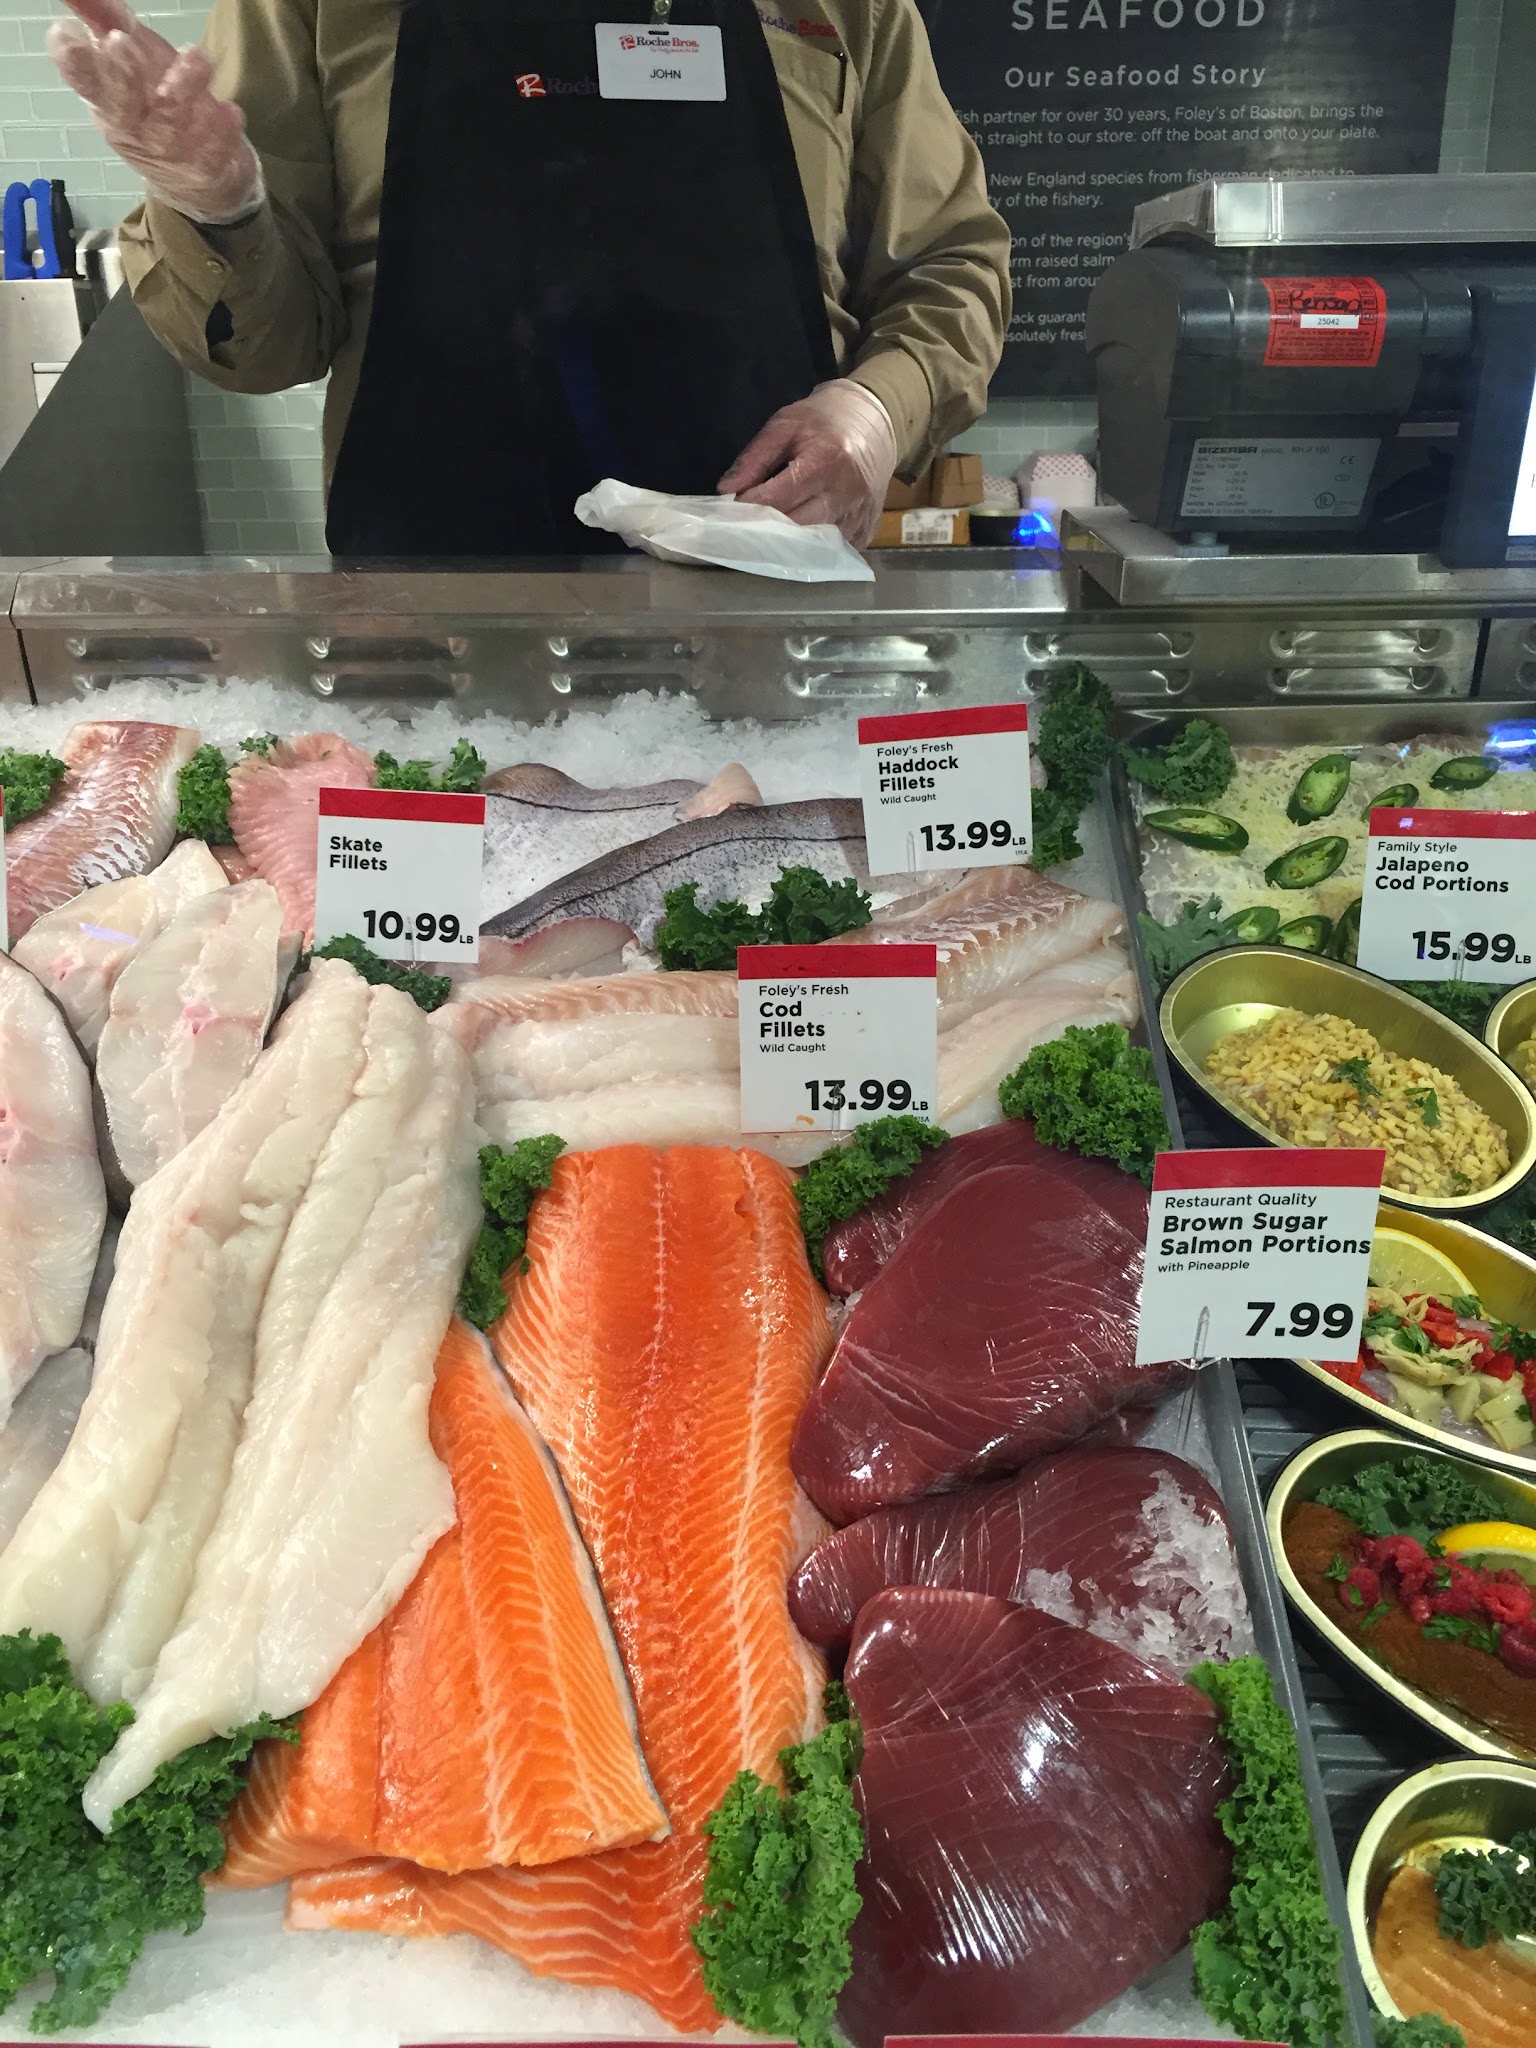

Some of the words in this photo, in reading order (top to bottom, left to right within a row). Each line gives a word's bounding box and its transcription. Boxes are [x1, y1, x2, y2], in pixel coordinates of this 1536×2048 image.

[1011, 0, 1265, 31] SEAFOOD
[636, 36, 671, 47] Roche
[672, 37, 699, 47] Bros.
[650, 69, 682, 80] JOHN
[1005, 67, 1054, 88] Our
[1066, 64, 1179, 87] Seafood
[1192, 64, 1265, 88] Story
[984, 110, 1037, 126] partner
[1041, 109, 1063, 122] for
[1067, 111, 1099, 122] over
[1105, 107, 1123, 121] 30
[1128, 109, 1170, 124] years,
[1175, 105, 1226, 122] Foley's
[1230, 104, 1246, 119] of
[1250, 105, 1305, 120] Boston,
[1310, 105, 1355, 121] brings
[1360, 104, 1384, 118] the
[988, 130, 1042, 146] straight
[1048, 132, 1063, 143] to
[1067, 133, 1090, 143] our
[1096, 130, 1137, 143] store:
[1141, 128, 1162, 142] off
[1166, 128, 1190, 141] the
[1194, 127, 1227, 141] boat
[1232, 126, 1259, 140] and
[1264, 128, 1297, 140] onto
[1301, 128, 1335, 142] your
[1340, 125, 1380, 141] plate.
[991, 173, 1022, 185] New
[1028, 171, 1085, 188] England
[1090, 170, 1143, 187] species
[1148, 169, 1182, 184] from
[1005, 192, 1021, 207] of
[1025, 193, 1047, 206] the
[1052, 192, 1103, 208] fishery.
[1031, 233, 1046, 247] of
[1050, 234, 1073, 247] the
[1035, 254, 1079, 267] raised
[1027, 274, 1060, 288] from
[1065, 276, 1100, 287] arou
[1010, 312, 1034, 324] ack
[1318, 318, 1340, 326] 25042
[877, 744, 918, 757] Foley's
[922, 742, 953, 753] Fresh
[878, 756, 959, 775] Haddock
[880, 776, 935, 792] Fillets
[880, 796, 901, 805] Wild
[904, 793, 936, 803] Caught
[920, 820, 1011, 851] 13.99
[1012, 837, 1026, 846] LB
[330, 836, 383, 852] Skate
[1378, 842, 1420, 854] Family
[1424, 842, 1457, 854] Style
[330, 854, 388, 871] Fillets
[1376, 857, 1469, 874] Jalapeno
[1375, 875, 1415, 890] Cod
[1423, 876, 1509, 893] Portions
[363, 910, 460, 943] 10.99
[460, 935, 474, 944] LB
[1412, 931, 1516, 963] 15.99
[1515, 955, 1531, 964] LB
[759, 985, 807, 997] Foley's
[812, 984, 849, 995] Fresh
[759, 1001, 802, 1017] Cod
[760, 1021, 825, 1038] Fillets
[760, 1043, 784, 1053] Wild
[788, 1043, 826, 1053] Caught
[805, 1079, 912, 1111] 13.99
[912, 1101, 929, 1111] LB
[1165, 1194, 1252, 1209] Restaurant
[1258, 1193, 1317, 1207] Quality
[1163, 1215, 1243, 1233] Brown
[1252, 1212, 1328, 1233] Sugar
[1160, 1236, 1252, 1256] Salmon
[1262, 1235, 1371, 1254] Portions
[1158, 1262, 1183, 1273] with
[1188, 1260, 1250, 1271] Pineapple
[1246, 1302, 1354, 1339] 7.99
